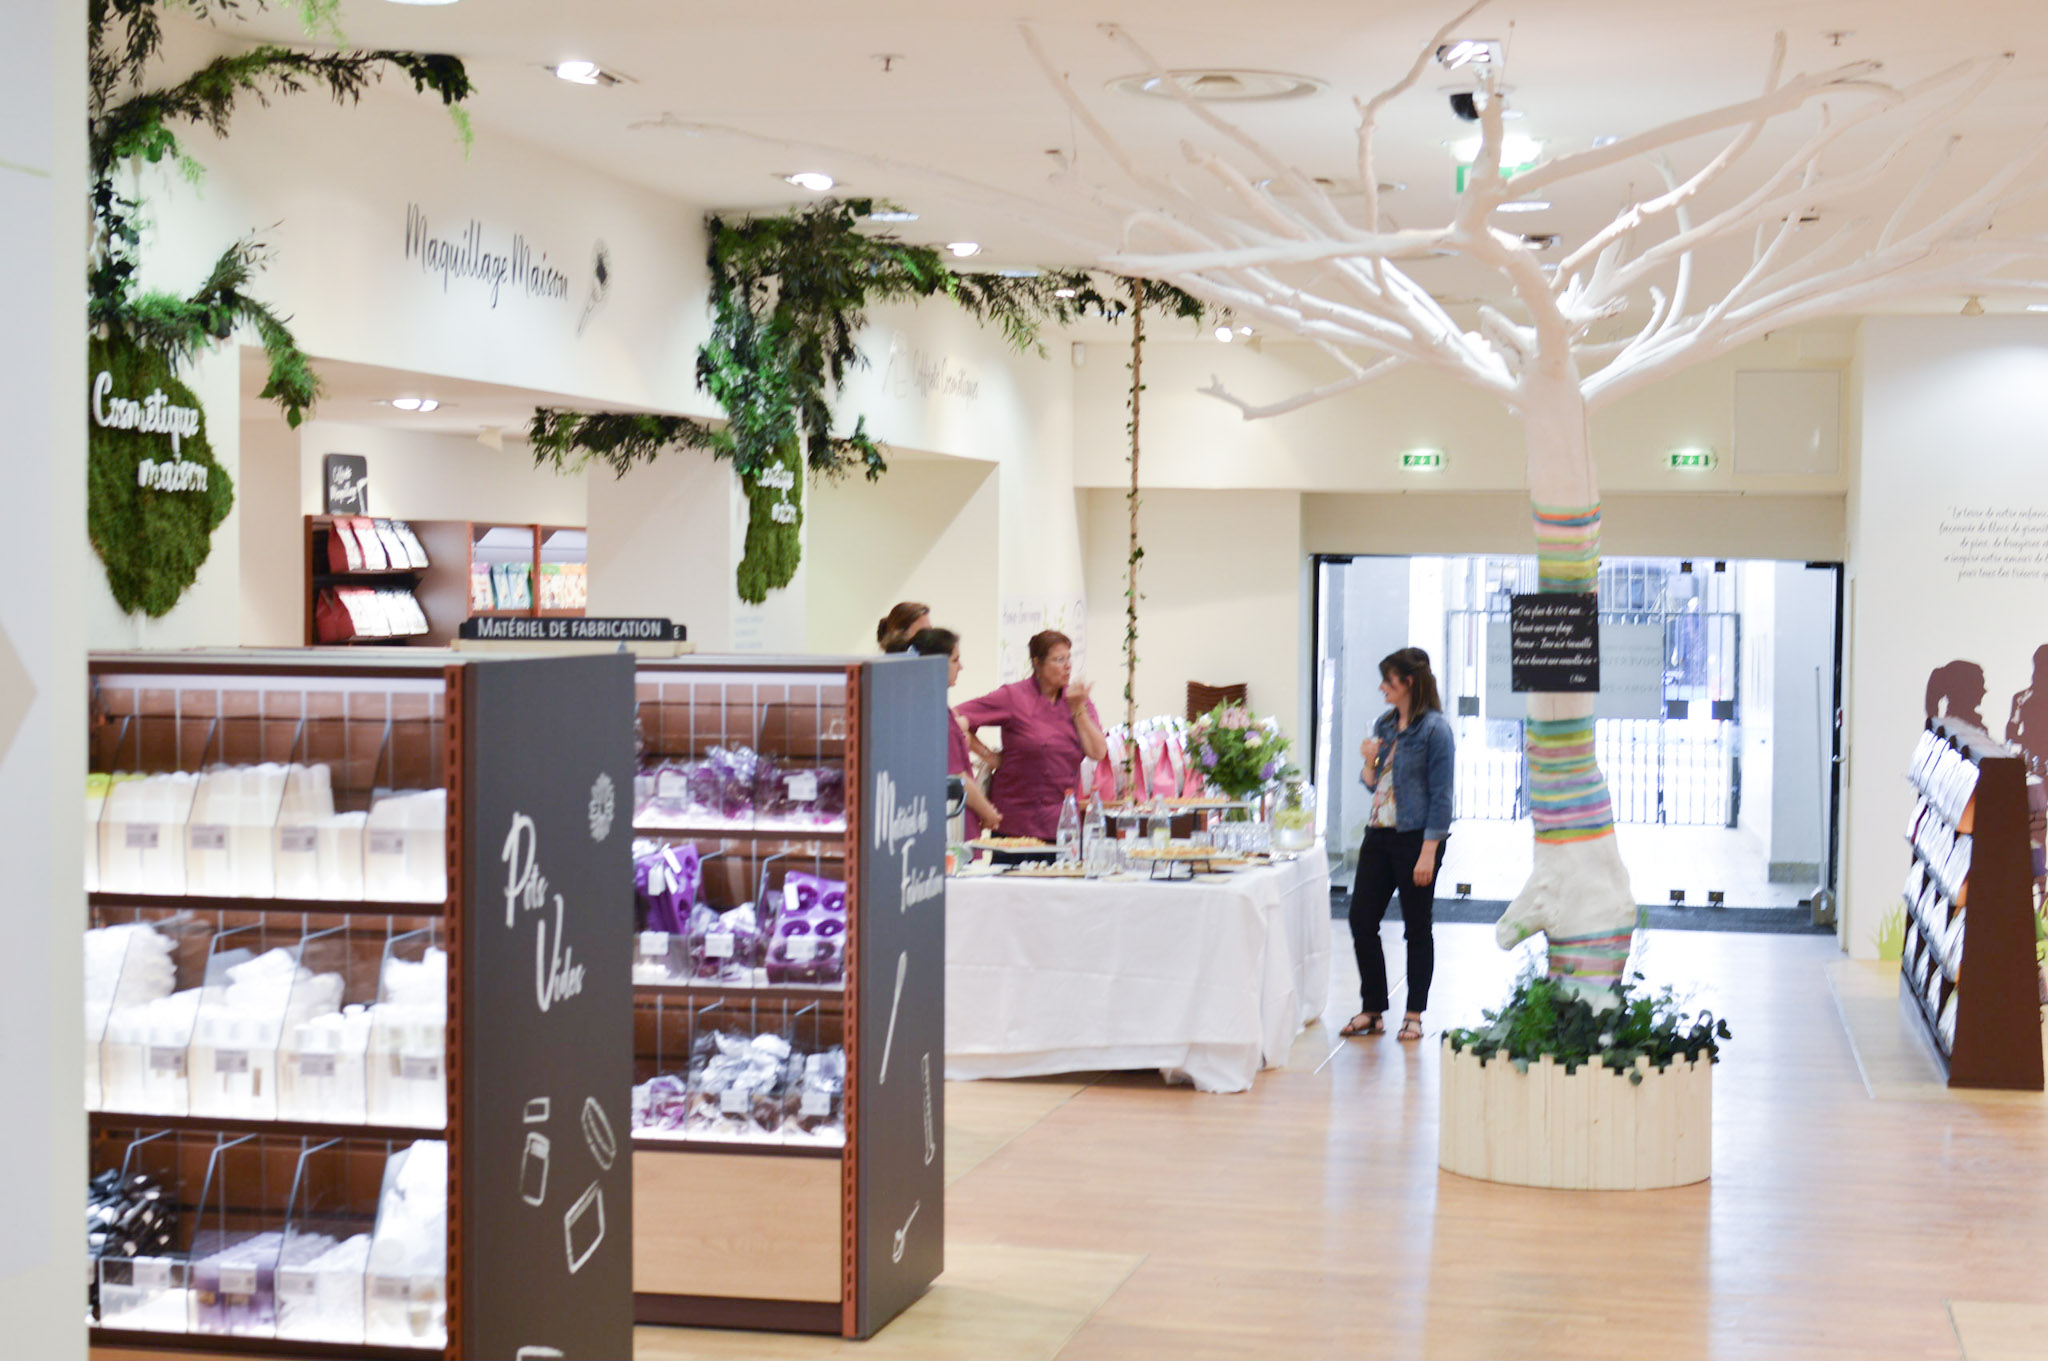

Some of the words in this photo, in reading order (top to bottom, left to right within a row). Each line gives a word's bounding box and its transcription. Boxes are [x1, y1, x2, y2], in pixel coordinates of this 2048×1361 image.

[405, 201, 508, 310] Maquillage
[512, 232, 568, 301] Maison
[92, 370, 200, 454] Cosmétique
[138, 453, 208, 493] maison
[477, 617, 547, 639] MATÉRIEL
[550, 620, 569, 639] DE
[571, 620, 662, 639] FABRICATION
[501, 810, 549, 929] Pots
[535, 892, 587, 1013] Vides
